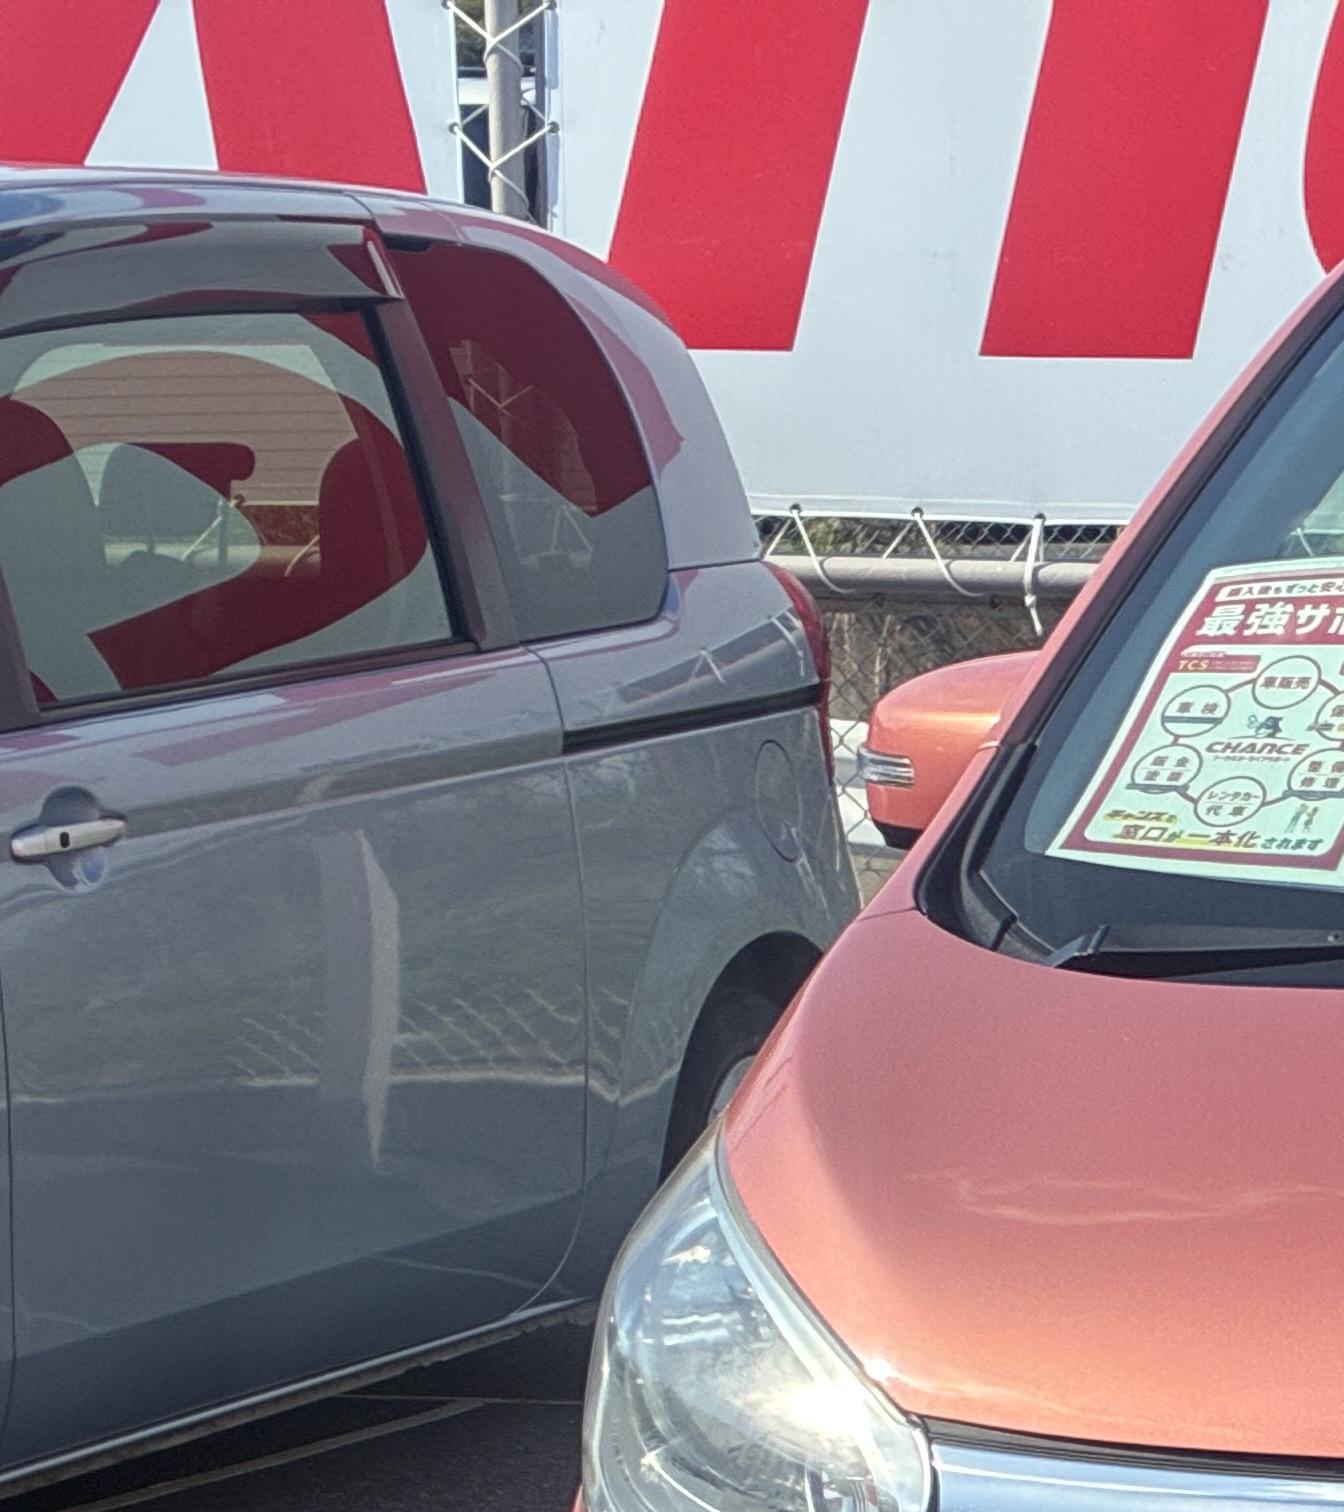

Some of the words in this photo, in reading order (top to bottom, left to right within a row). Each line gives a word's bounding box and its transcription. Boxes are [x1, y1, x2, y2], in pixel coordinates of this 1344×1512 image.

[1178, 659, 1210, 671] TCS
[1205, 741, 1312, 756] CHANCE
[1206, 790, 1261, 803] レンタカー
